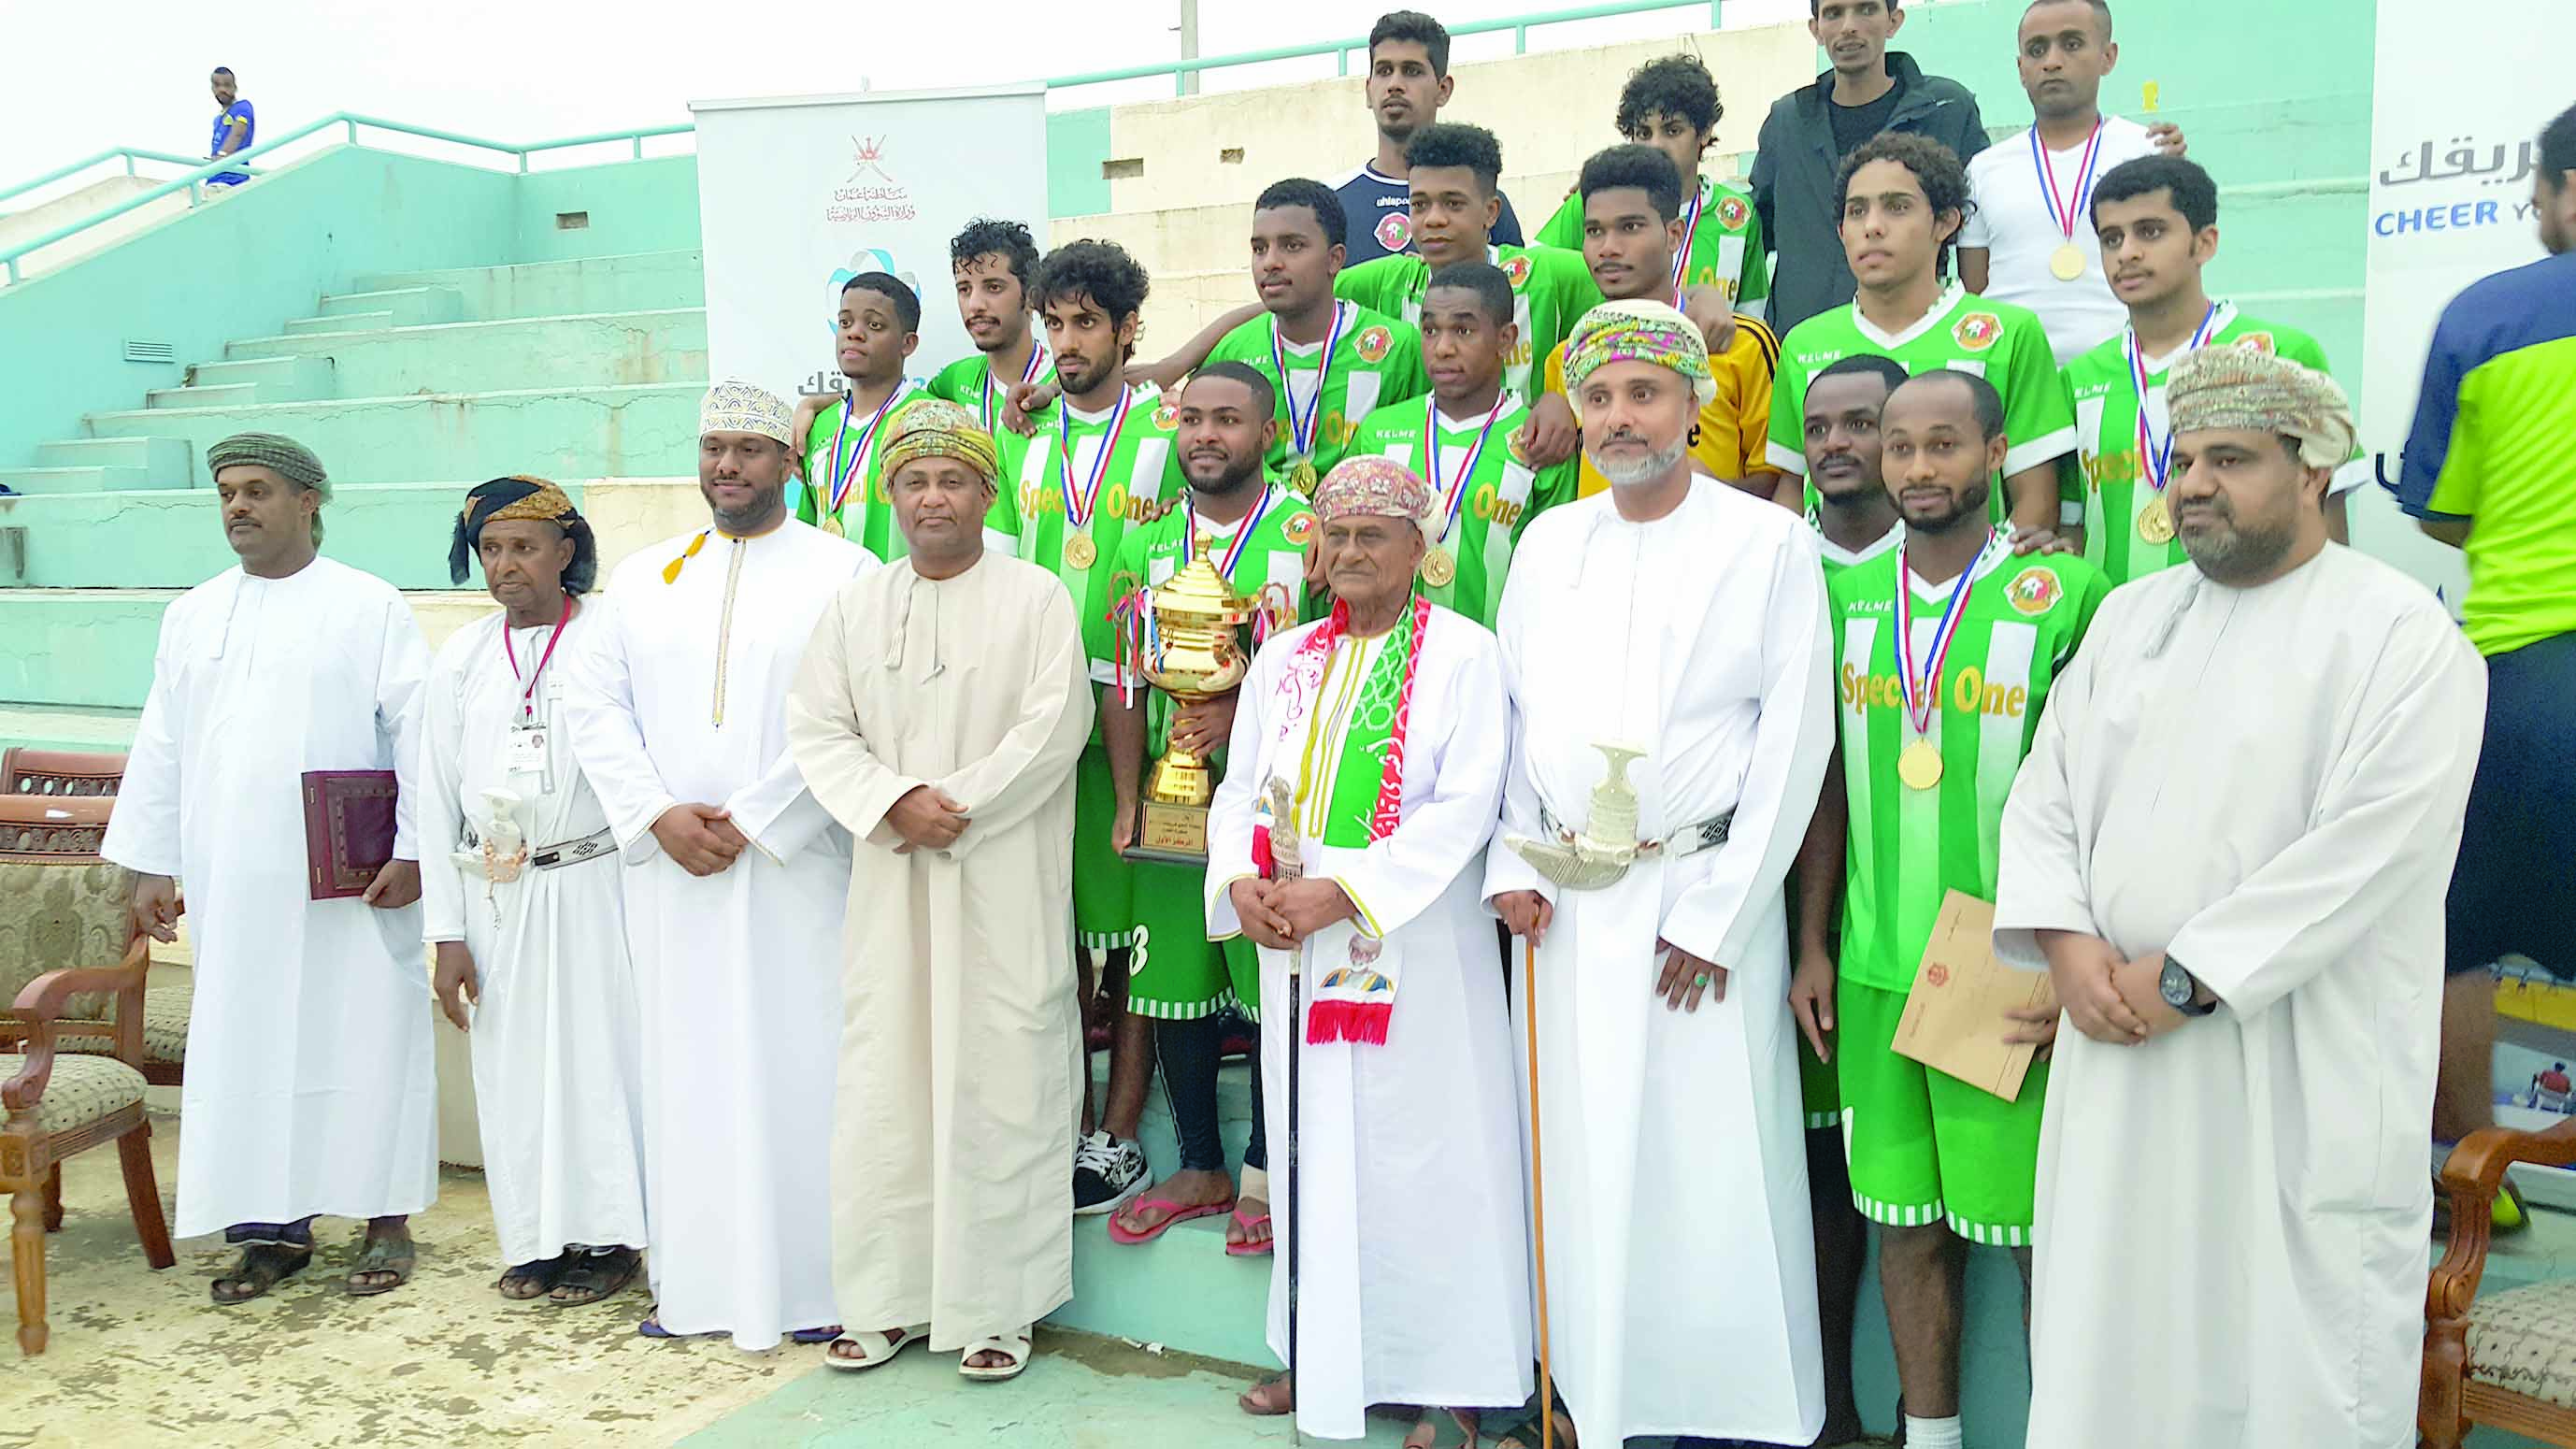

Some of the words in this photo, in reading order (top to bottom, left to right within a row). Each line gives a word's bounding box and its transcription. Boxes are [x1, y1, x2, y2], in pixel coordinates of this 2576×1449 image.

[2379, 135, 2536, 186] ريقك
[1376, 195, 1410, 207] uhlspo
[2375, 199, 2498, 236] CHEER
[1505, 340, 1532, 367] ne
[1376, 429, 1416, 439] KELME
[1107, 482, 1154, 520] One
[1473, 482, 1522, 526] One
[1848, 599, 1893, 612] KELME
[1842, 661, 1943, 715] Specal
[1954, 665, 2025, 718] One
